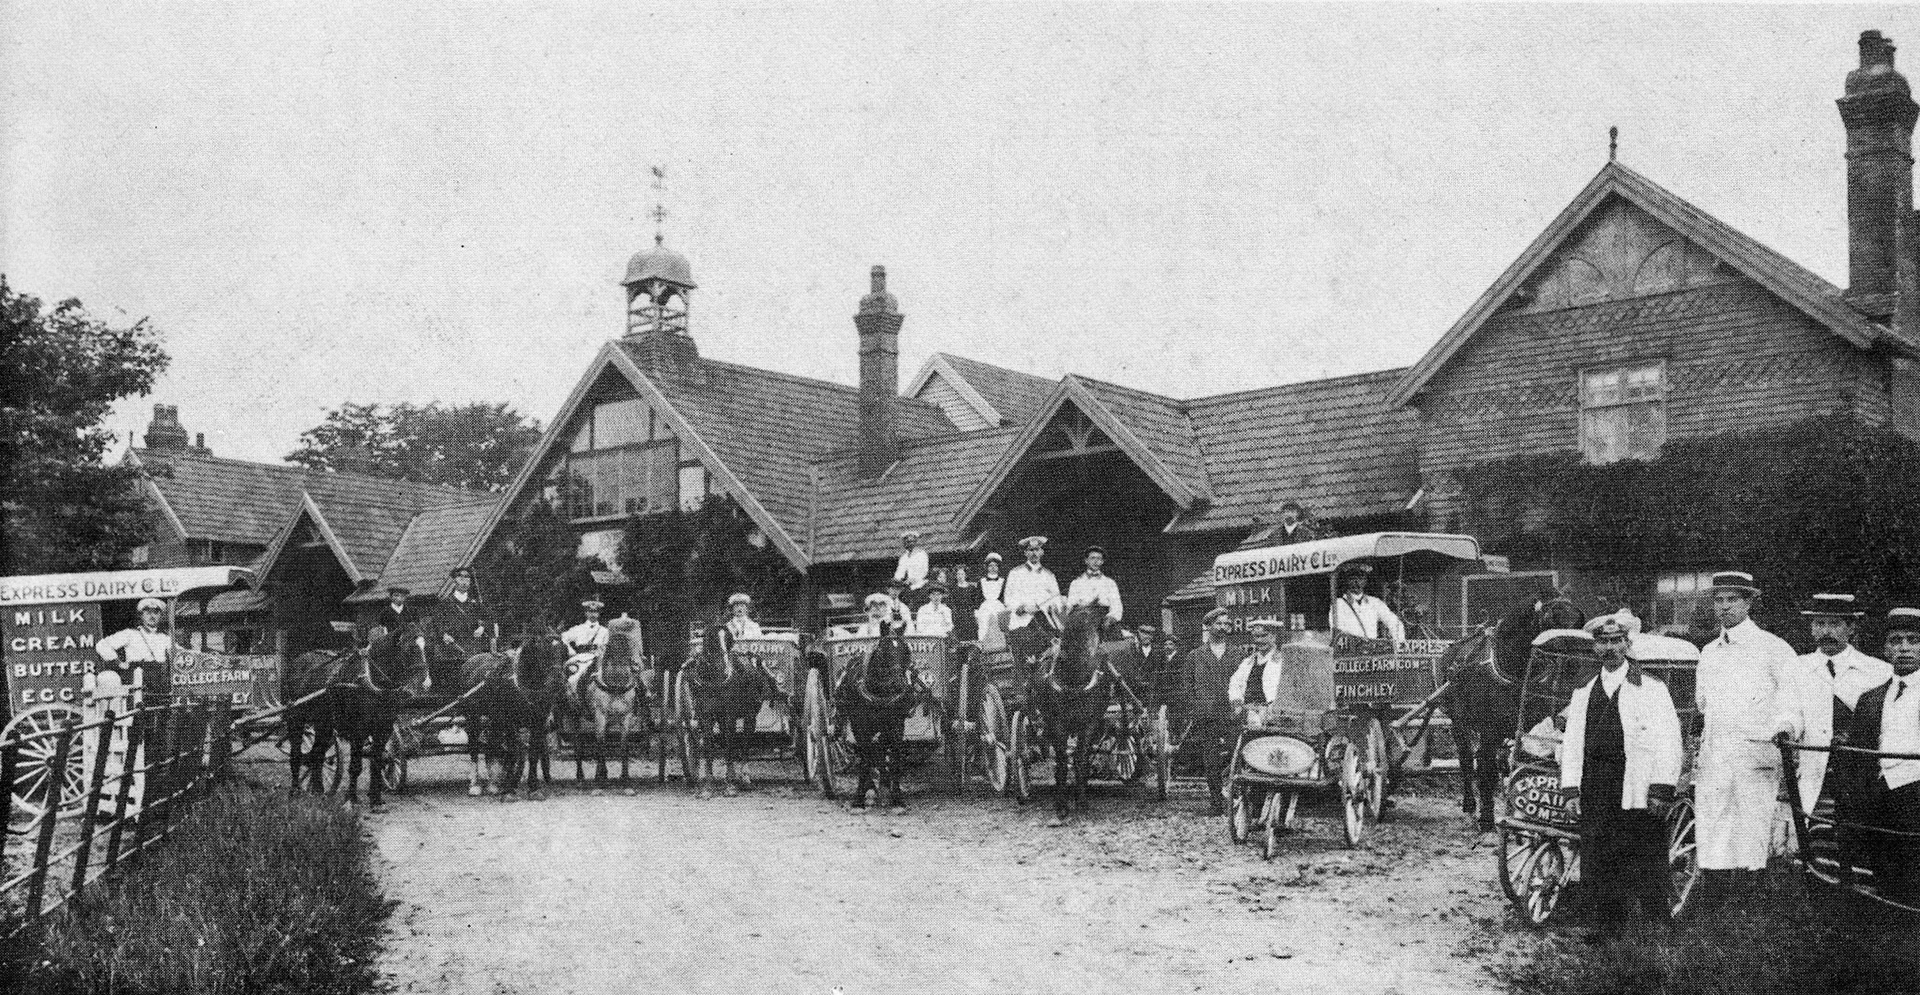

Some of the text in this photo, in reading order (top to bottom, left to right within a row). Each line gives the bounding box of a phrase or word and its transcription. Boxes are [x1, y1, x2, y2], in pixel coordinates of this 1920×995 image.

[1215, 561, 1266, 581] EXPRESS
[1269, 553, 1308, 575] DAIRY
[0, 582, 79, 601] EXPRESS
[84, 580, 137, 597] DAIRY
[1225, 586, 1271, 606] MILK
[15, 608, 85, 626] MILK
[11, 634, 94, 651] CREAM
[14, 660, 96, 677] BUTTER
[175, 655, 194, 667] 49
[1333, 660, 1371, 673] COLLEGE
[172, 670, 250, 685] COLLEGE FARM
[22, 687, 75, 704] EGG
[1335, 682, 1396, 697] FINCHLEY
[1515, 775, 1559, 792] EXPR
